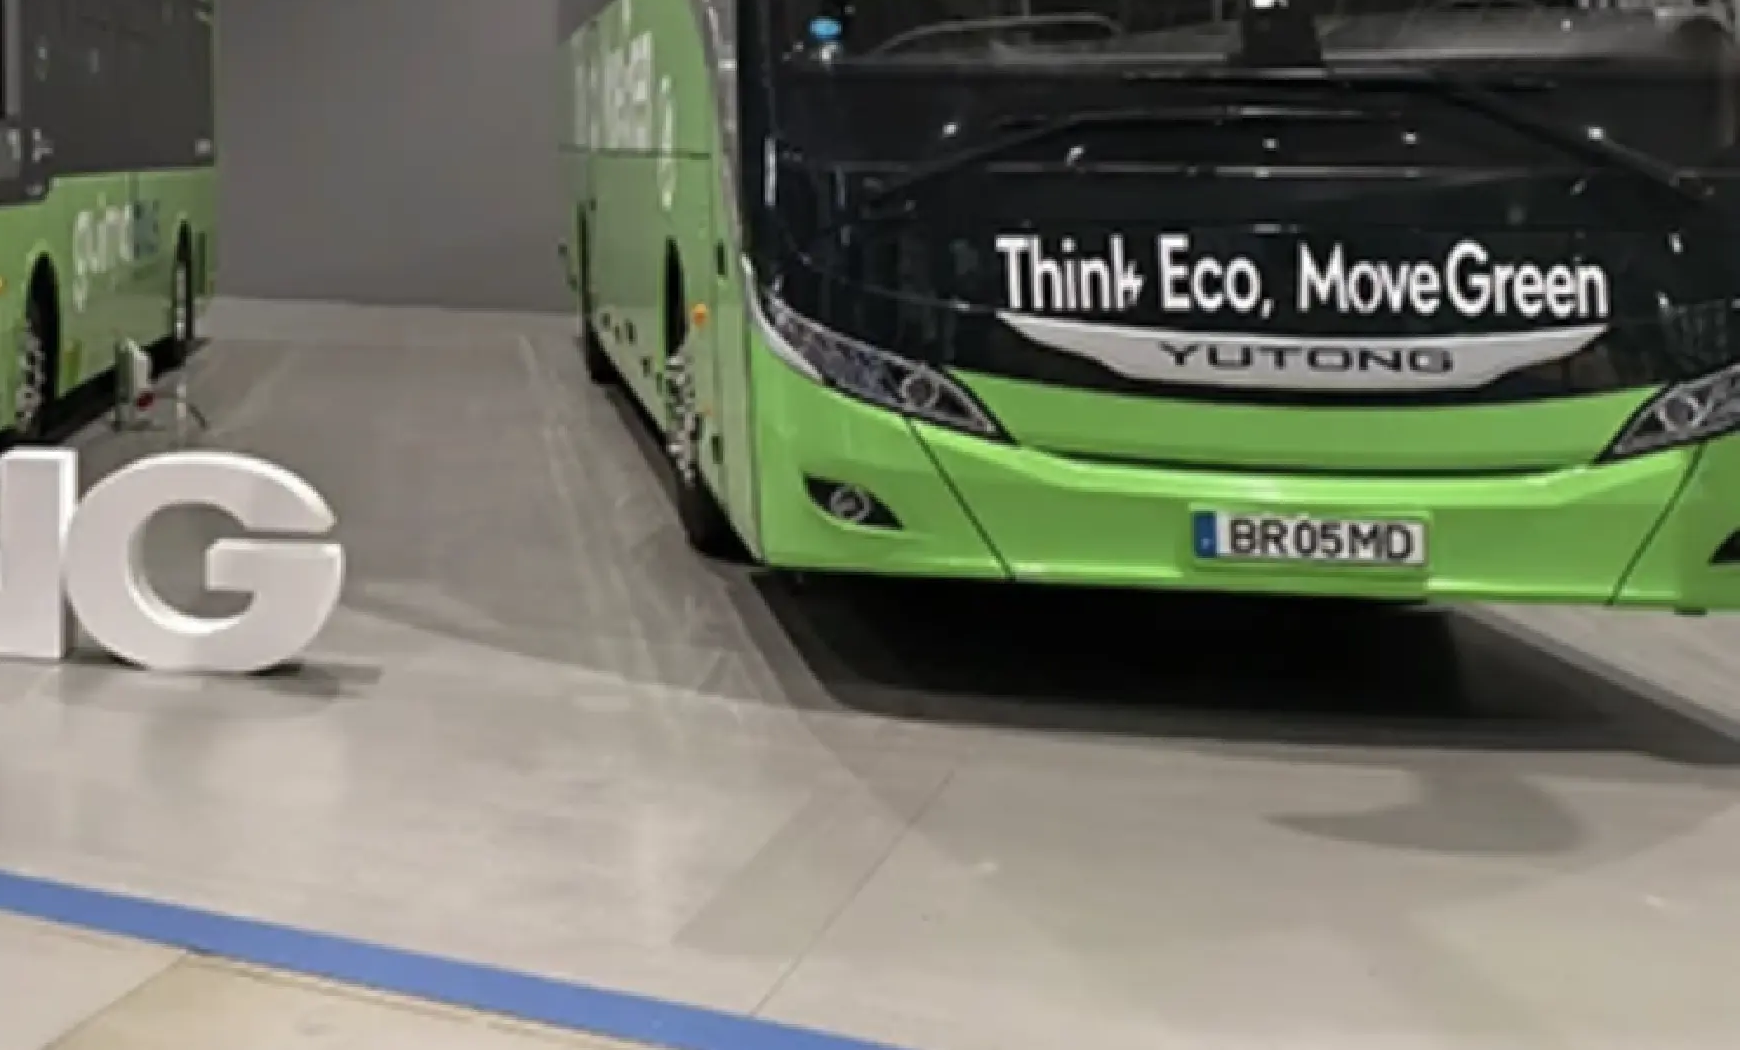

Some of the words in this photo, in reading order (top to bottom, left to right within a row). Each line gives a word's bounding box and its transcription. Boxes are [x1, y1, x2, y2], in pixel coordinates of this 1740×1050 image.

[994, 234, 1145, 311] Think
[1158, 234, 1275, 320] Eco,
[1297, 240, 1440, 316] Move
[1446, 238, 1607, 318] Green
[1159, 341, 1453, 373] YUTONG
